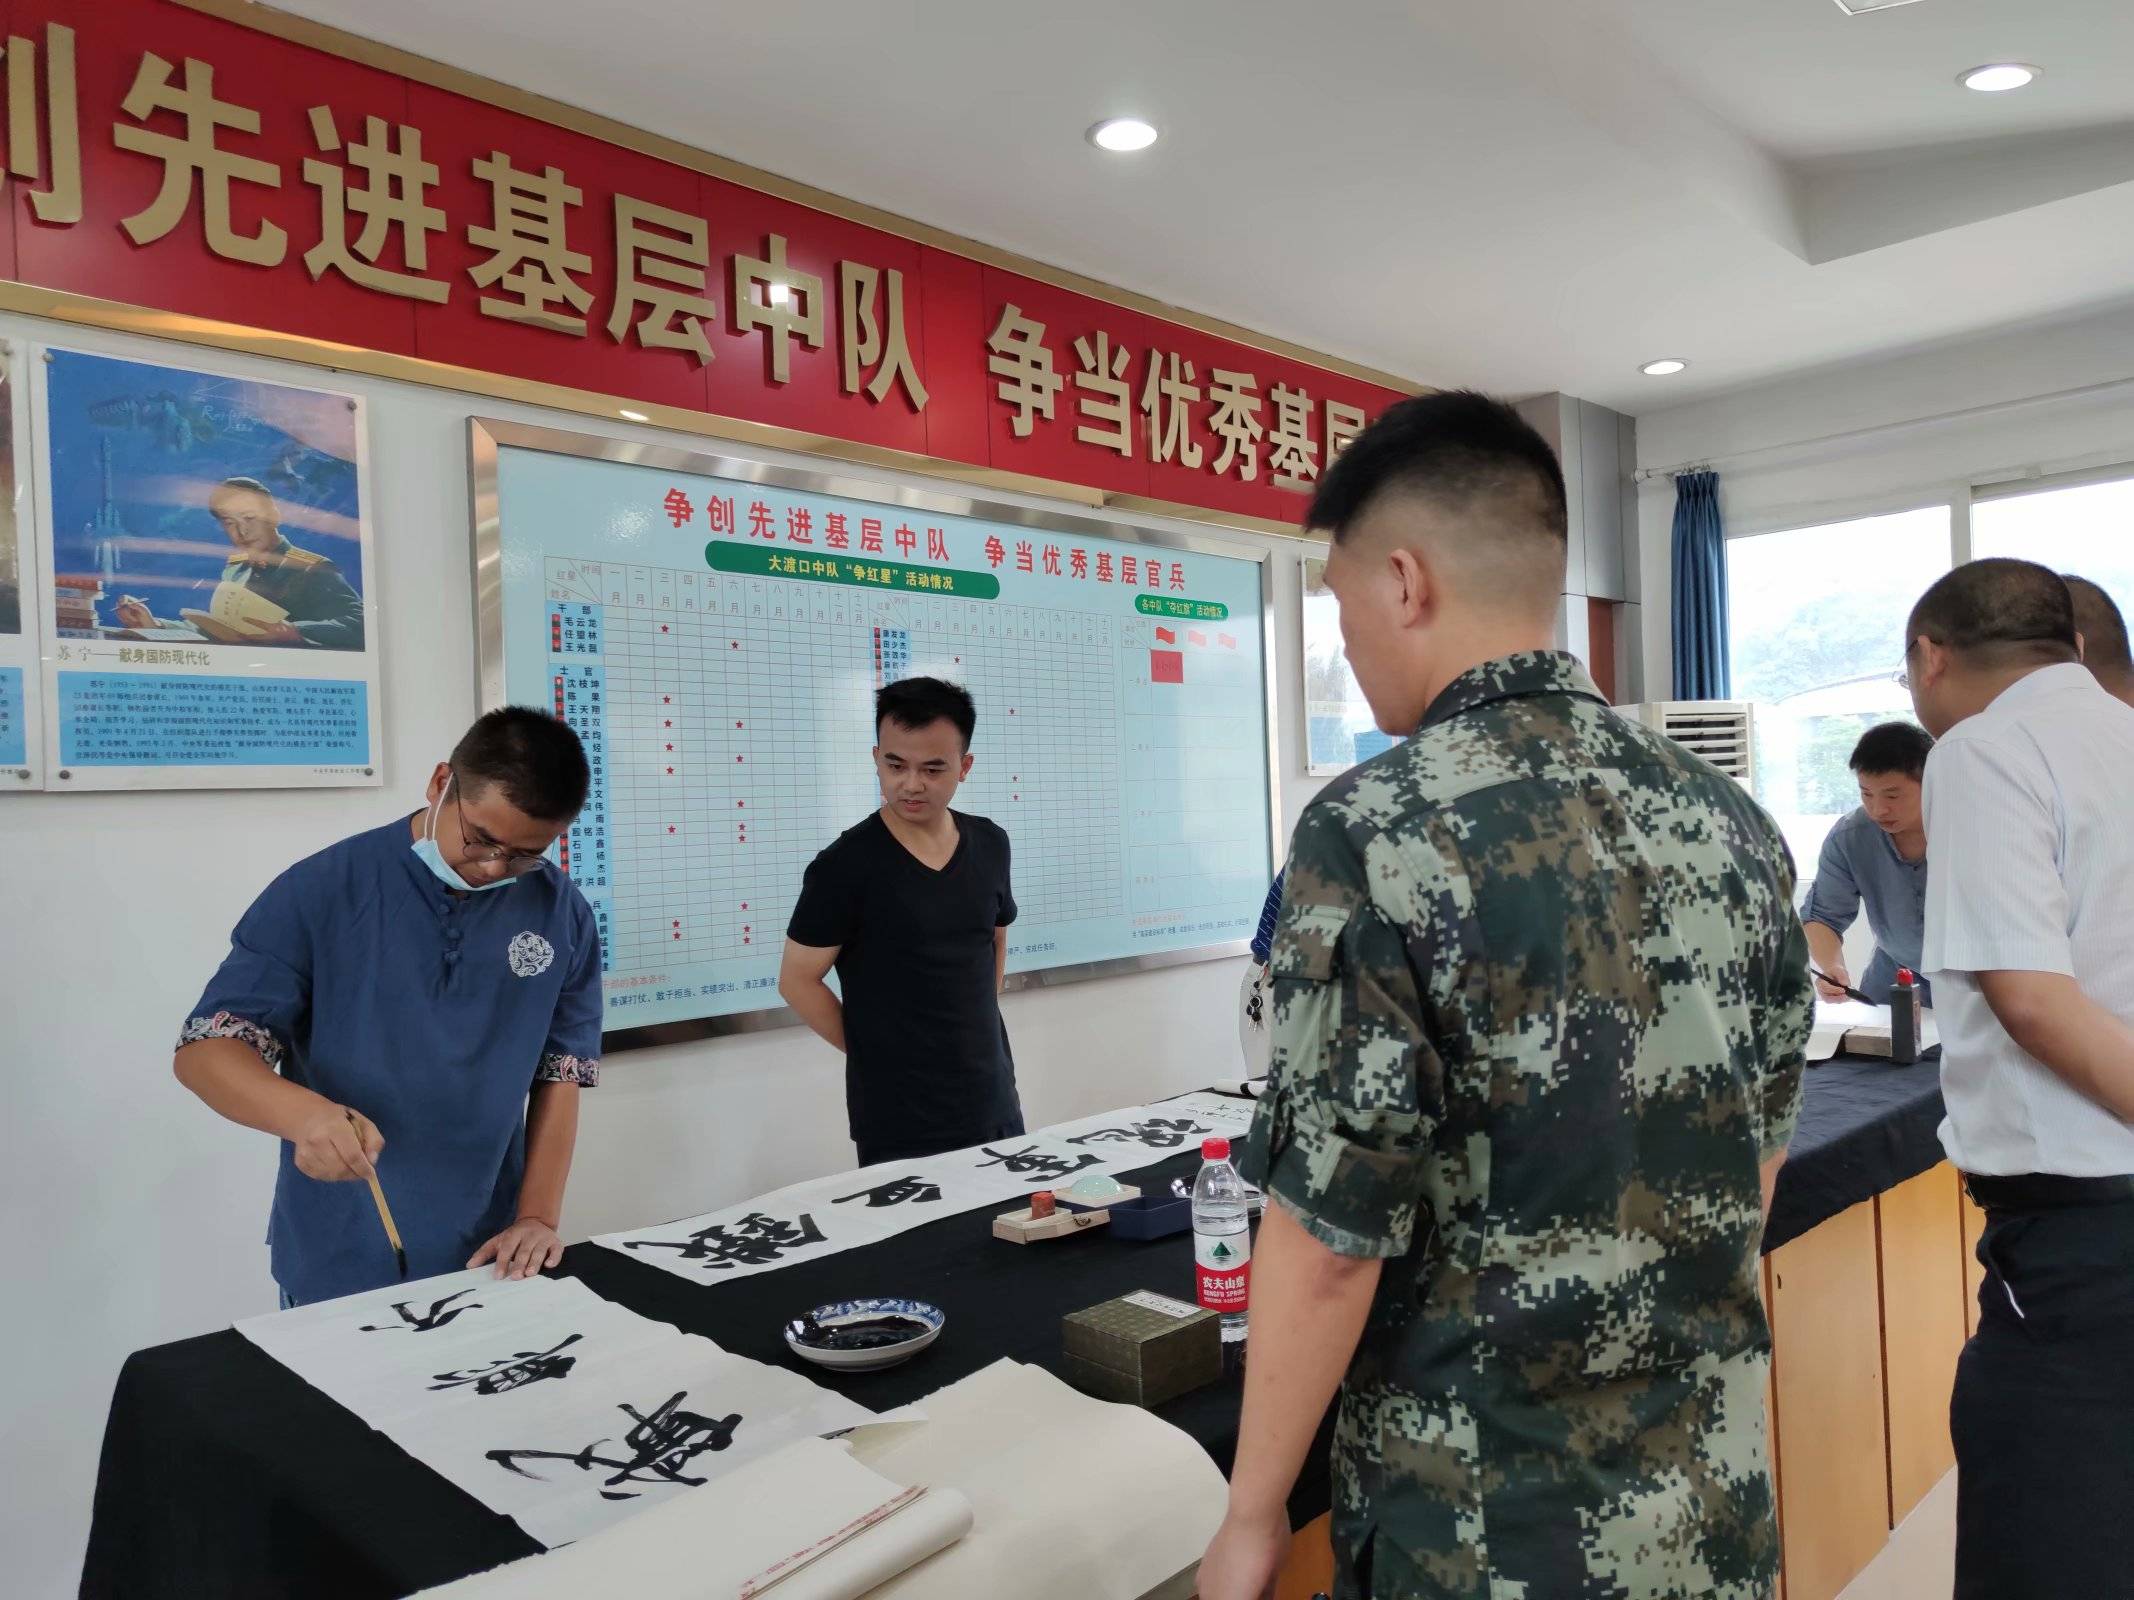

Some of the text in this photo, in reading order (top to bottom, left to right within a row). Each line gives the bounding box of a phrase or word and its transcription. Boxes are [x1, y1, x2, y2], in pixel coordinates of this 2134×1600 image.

[663, 487, 1185, 591] 争创先进基层中队 争当优秀基层官兵
